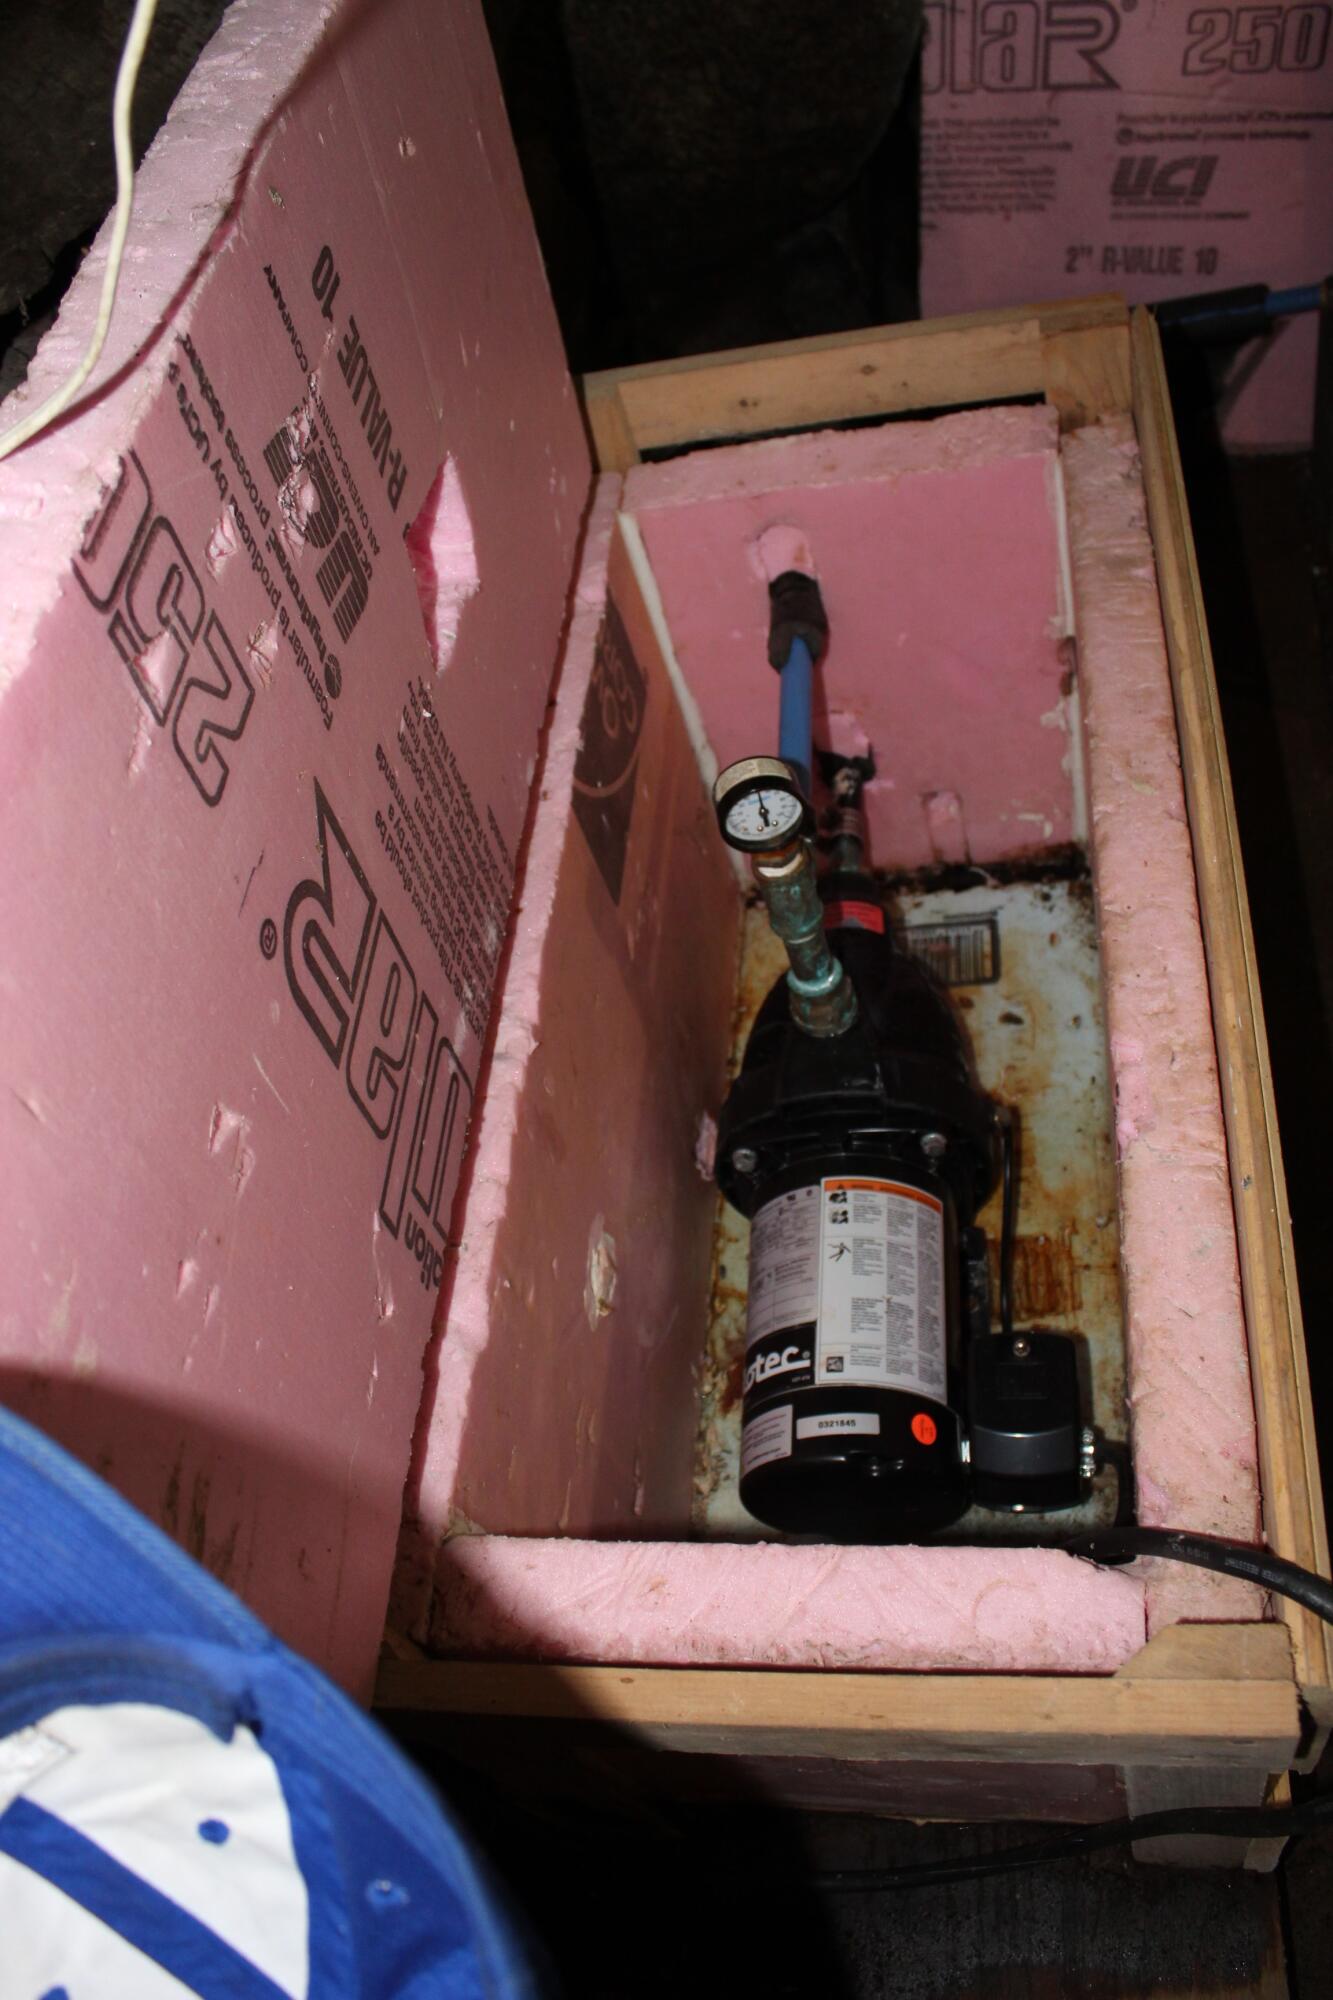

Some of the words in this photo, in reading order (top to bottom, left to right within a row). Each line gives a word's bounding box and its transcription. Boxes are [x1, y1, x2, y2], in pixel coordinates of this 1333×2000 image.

[1182, 5, 1332, 76] 250
[1111, 155, 1219, 196] UCI
[311, 245, 340, 324] 10
[1101, 246, 1184, 276] R-VALUE
[1196, 245, 1219, 276] 10
[263, 264, 308, 374] COMPANY
[176, 382, 210, 464] UCI's
[336, 315, 408, 514] R-VALUE
[210, 459, 228, 501] by
[224, 428, 270, 530] process
[318, 439, 362, 554] INDUSTRIES,
[230, 494, 281, 611] produced
[360, 543, 373, 581] UC
[367, 527, 380, 556] AN
[278, 606, 289, 637] is
[289, 629, 333, 731] Foamular
[375, 743, 424, 853] recommends
[424, 790, 436, 823] For
[453, 798, 465, 830] UC
[375, 810, 386, 844] be
[394, 817, 406, 850] by
[384, 833, 413, 893] should
[411, 886, 440, 949] product
[454, 917, 465, 949] UC
[817, 1419, 857, 1430] 0321845
